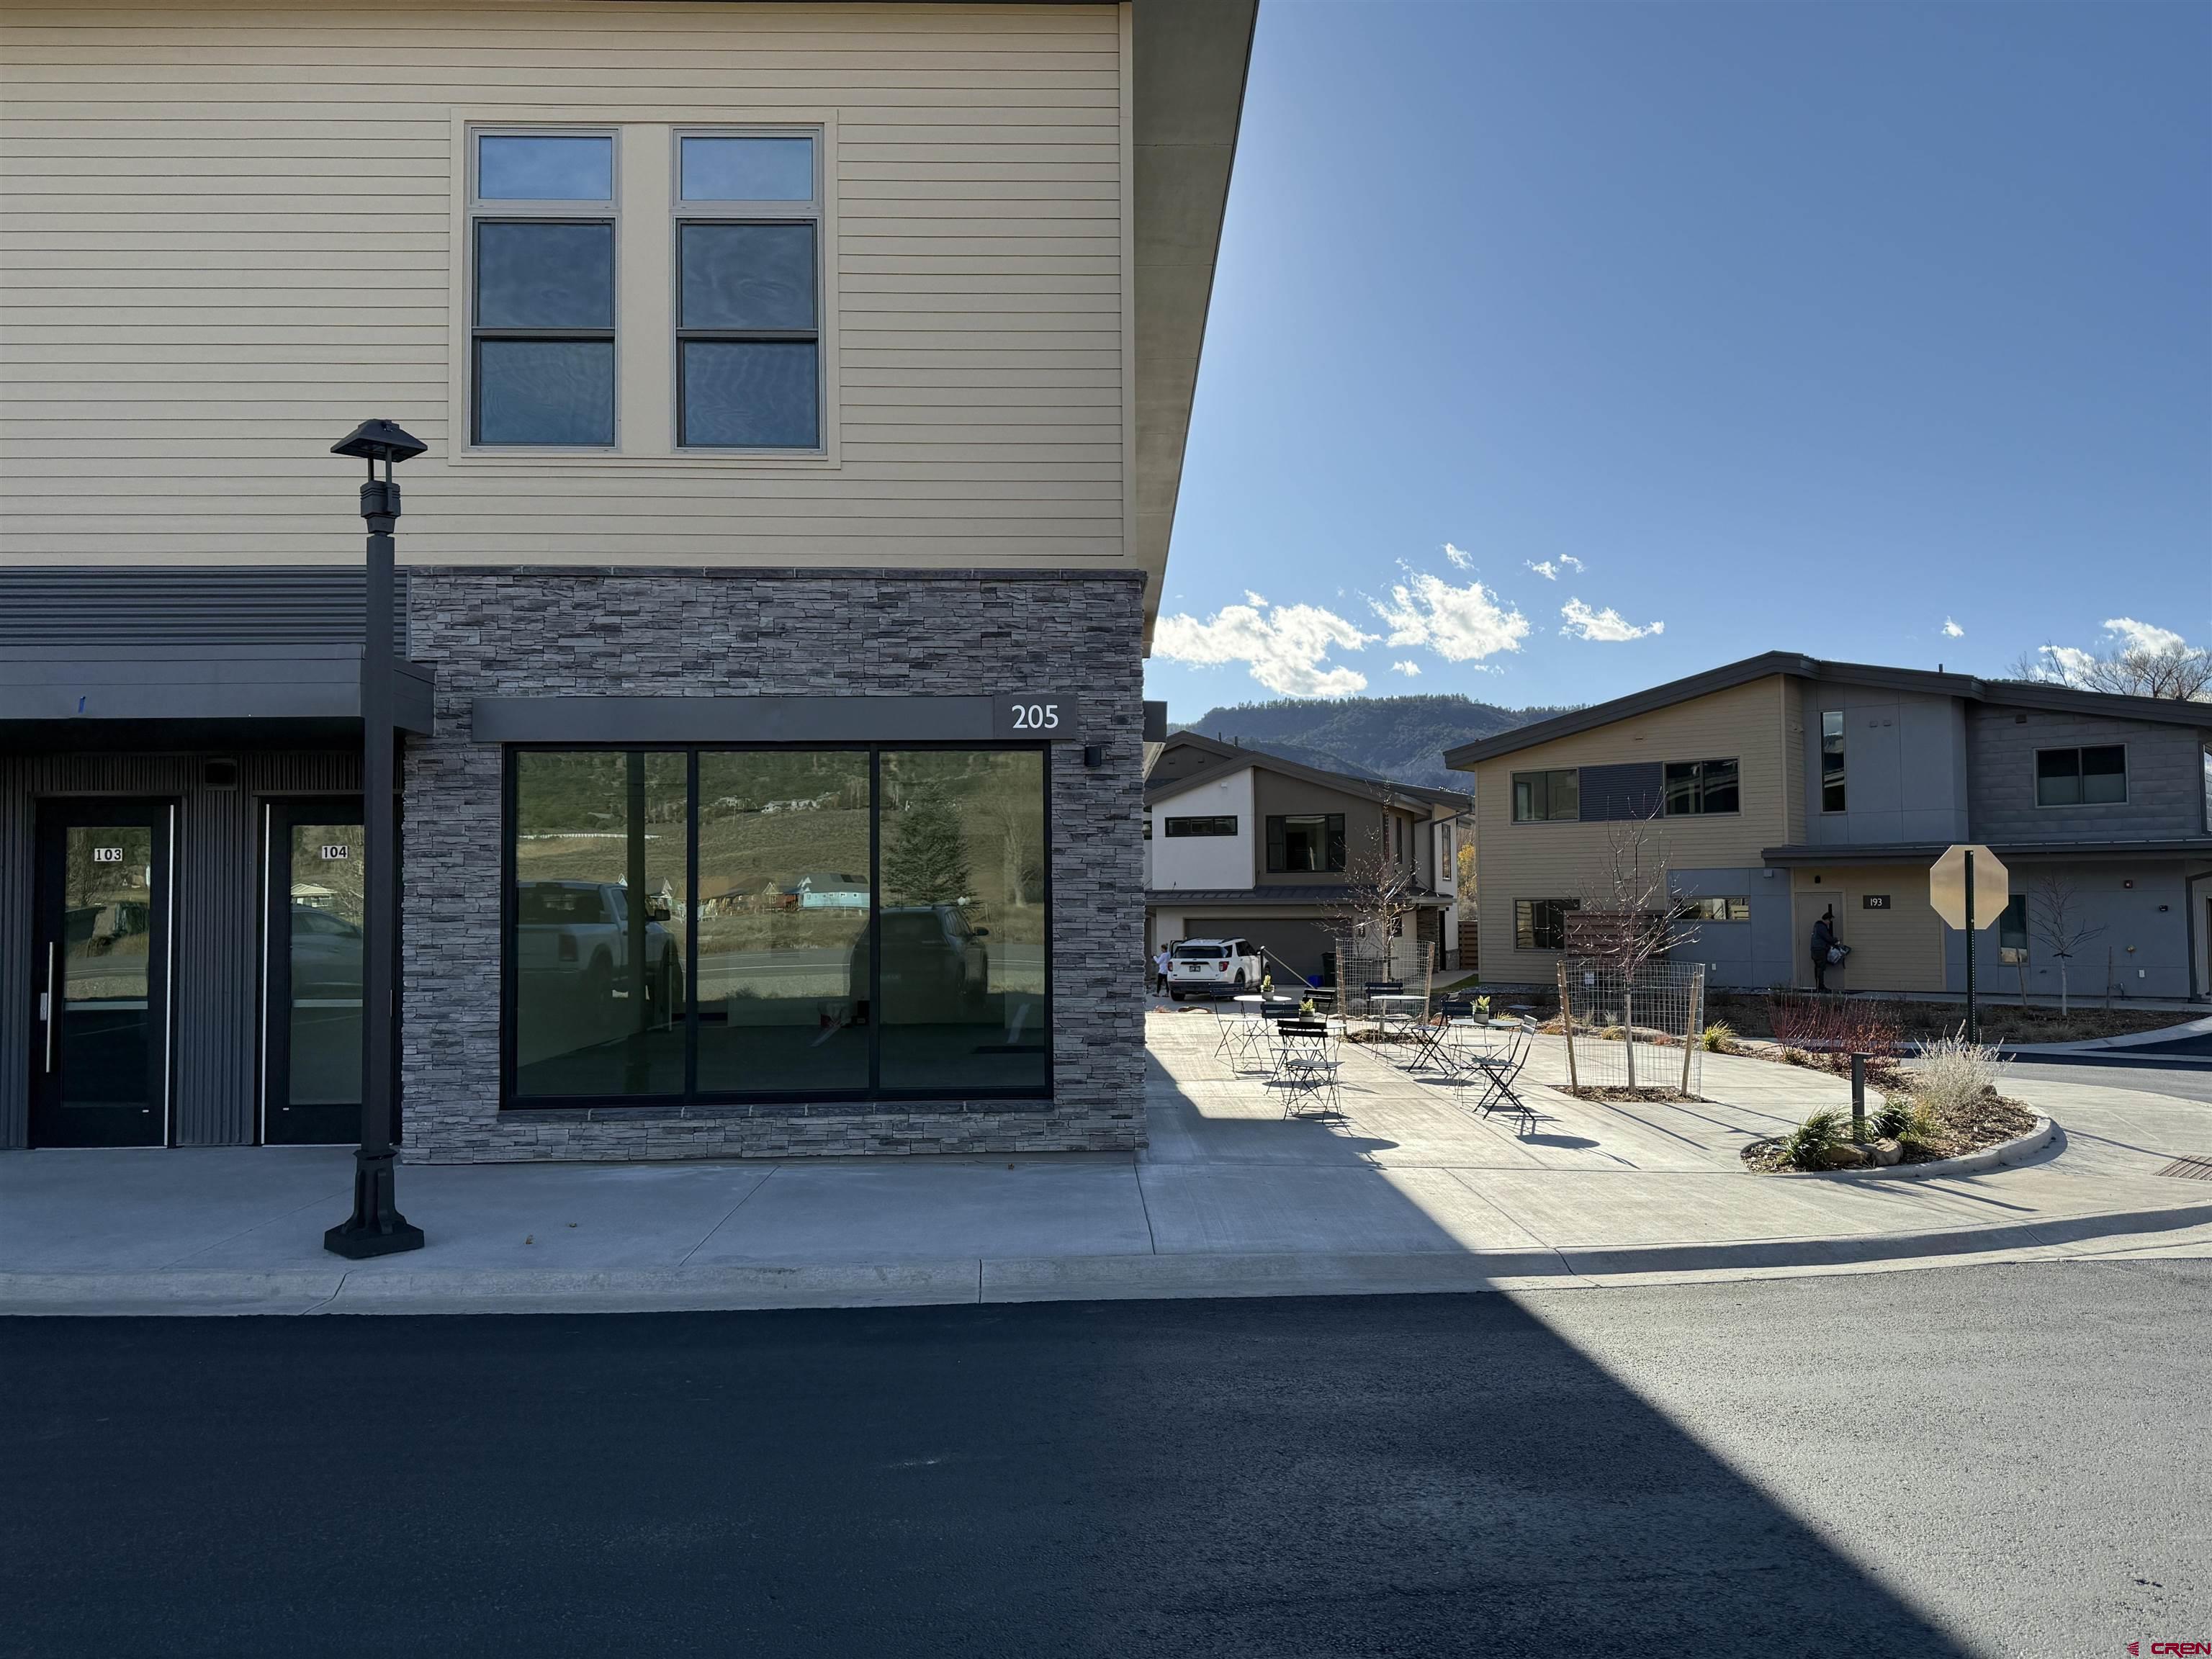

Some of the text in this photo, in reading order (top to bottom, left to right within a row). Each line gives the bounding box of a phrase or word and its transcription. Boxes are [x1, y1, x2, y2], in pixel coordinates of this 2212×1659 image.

[1012, 704, 1058, 729] 205
[96, 849, 121, 860] 103
[323, 846, 346, 858] 104
[1870, 898, 1882, 907] 193
